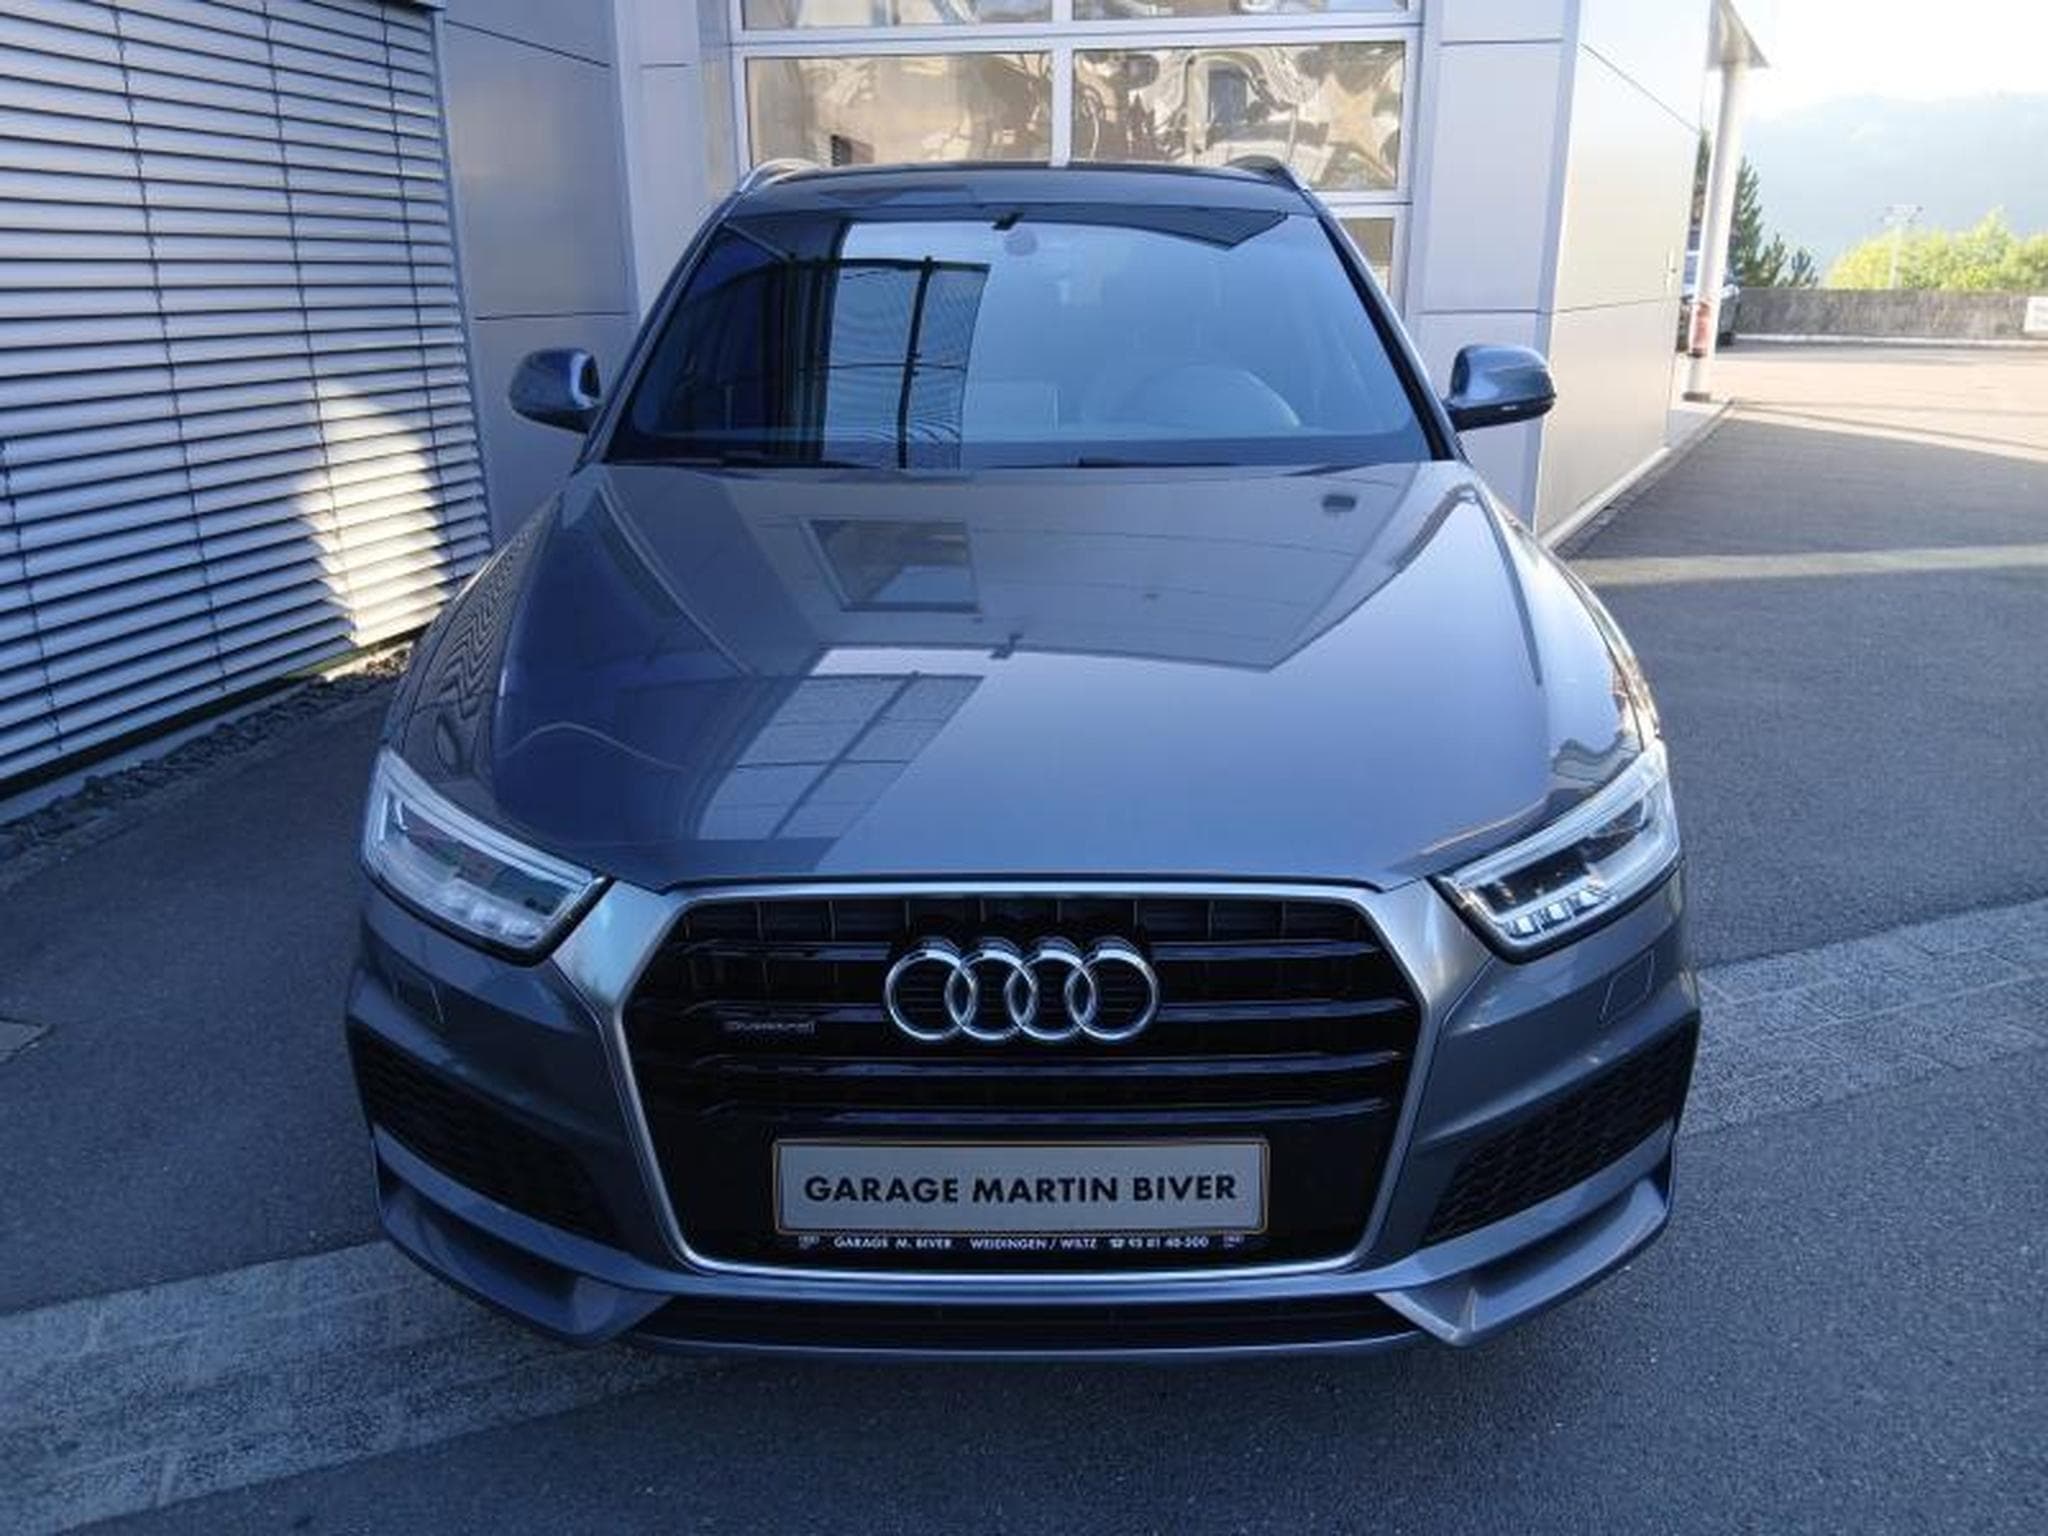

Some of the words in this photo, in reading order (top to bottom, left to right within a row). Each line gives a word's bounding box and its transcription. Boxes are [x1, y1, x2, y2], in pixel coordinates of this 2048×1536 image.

[804, 1176, 958, 1203] GARAGE
[972, 1176, 1117, 1203] MARTIN
[1133, 1174, 1235, 1201] BIVER
[833, 1236, 889, 1249] GARAGE
[916, 1238, 952, 1249] BIVER
